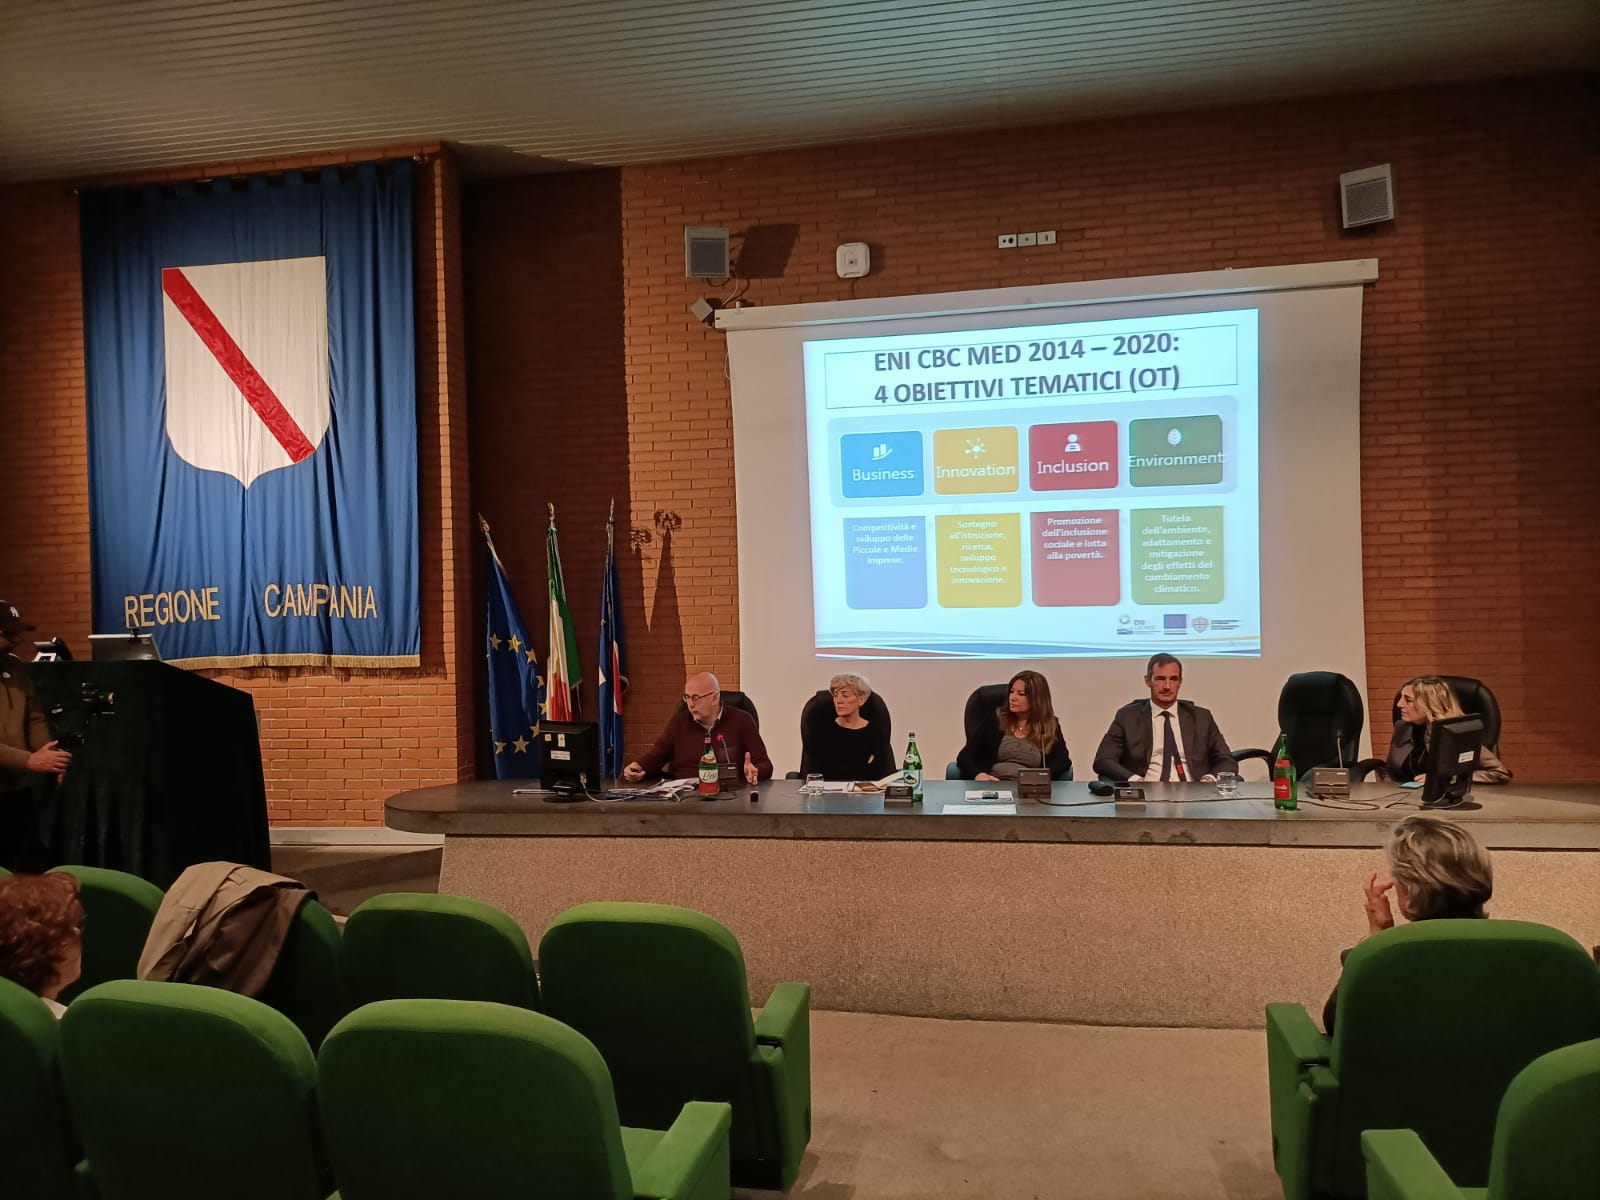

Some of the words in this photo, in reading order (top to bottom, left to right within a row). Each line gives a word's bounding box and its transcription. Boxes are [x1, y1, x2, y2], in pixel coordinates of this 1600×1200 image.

[874, 352, 911, 371] ENI
[917, 348, 962, 369] CBC
[967, 344, 1021, 366] MED
[1029, 339, 1085, 362] 2014
[1113, 332, 1180, 357] 2020:
[874, 385, 889, 404] 4
[893, 377, 1004, 403] OBIETTIVI
[1010, 370, 1122, 396] TEMATICI
[1129, 365, 1180, 393] (OT)
[1128, 450, 1225, 468] Environment
[936, 462, 1016, 479] Innovation
[1036, 458, 1109, 475] Inclusion
[852, 467, 914, 482] Business
[1047, 516, 1102, 526] Promozione
[1161, 514, 1191, 523] Tutela
[957, 520, 997, 530] Sostegno
[855, 534, 891, 544] sviluppo
[892, 533, 914, 542] delle
[1142, 538, 1203, 547] adattamento
[1043, 540, 1075, 549] sociale
[1084, 539, 1107, 548] lotta
[852, 545, 881, 554] Piccole
[891, 545, 918, 553] Medie
[1149, 549, 1204, 559] mitigazione
[1047, 552, 1063, 560] alla
[1141, 561, 1164, 571] degli
[1165, 560, 1195, 569] effetti
[1145, 572, 1210, 581] cambiamento
[1154, 584, 1200, 593] climatico.
[124, 586, 220, 628] REGIONE
[264, 583, 378, 618] CAMPANIA
